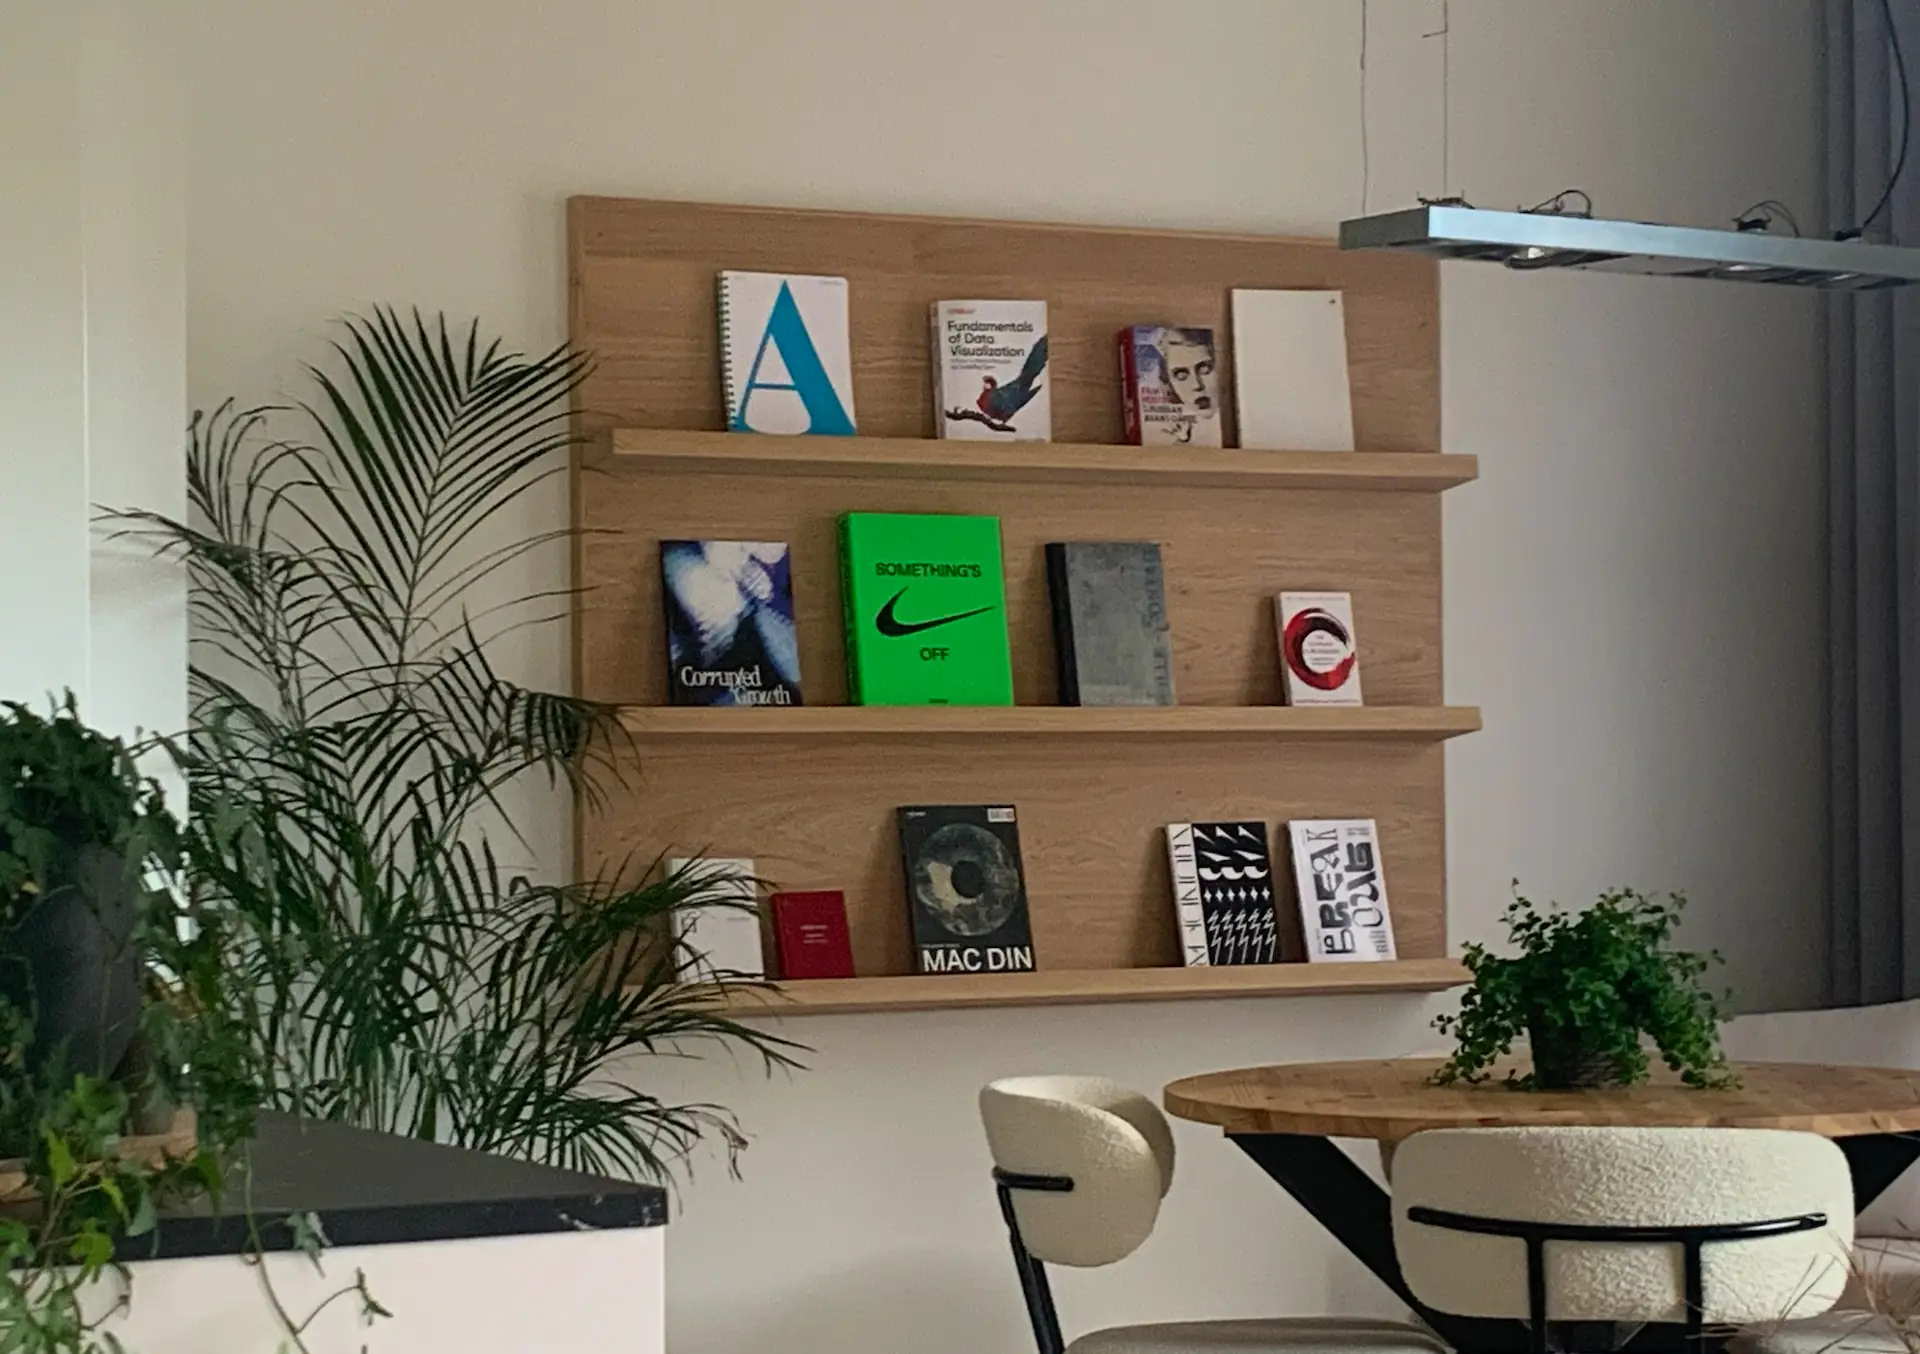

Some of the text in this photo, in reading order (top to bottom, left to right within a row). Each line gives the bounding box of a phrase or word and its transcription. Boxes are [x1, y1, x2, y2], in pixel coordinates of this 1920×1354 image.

[947, 320, 1034, 333] Fundamentals
[948, 332, 995, 344] of Data
[728, 279, 857, 436] A
[950, 345, 1026, 357] Visualization
[875, 562, 982, 578] SOMETHING'S
[920, 647, 950, 661] OFF
[681, 664, 763, 692] Corrupted
[729, 684, 792, 705] Growth
[922, 946, 1033, 973] MAC DIN
